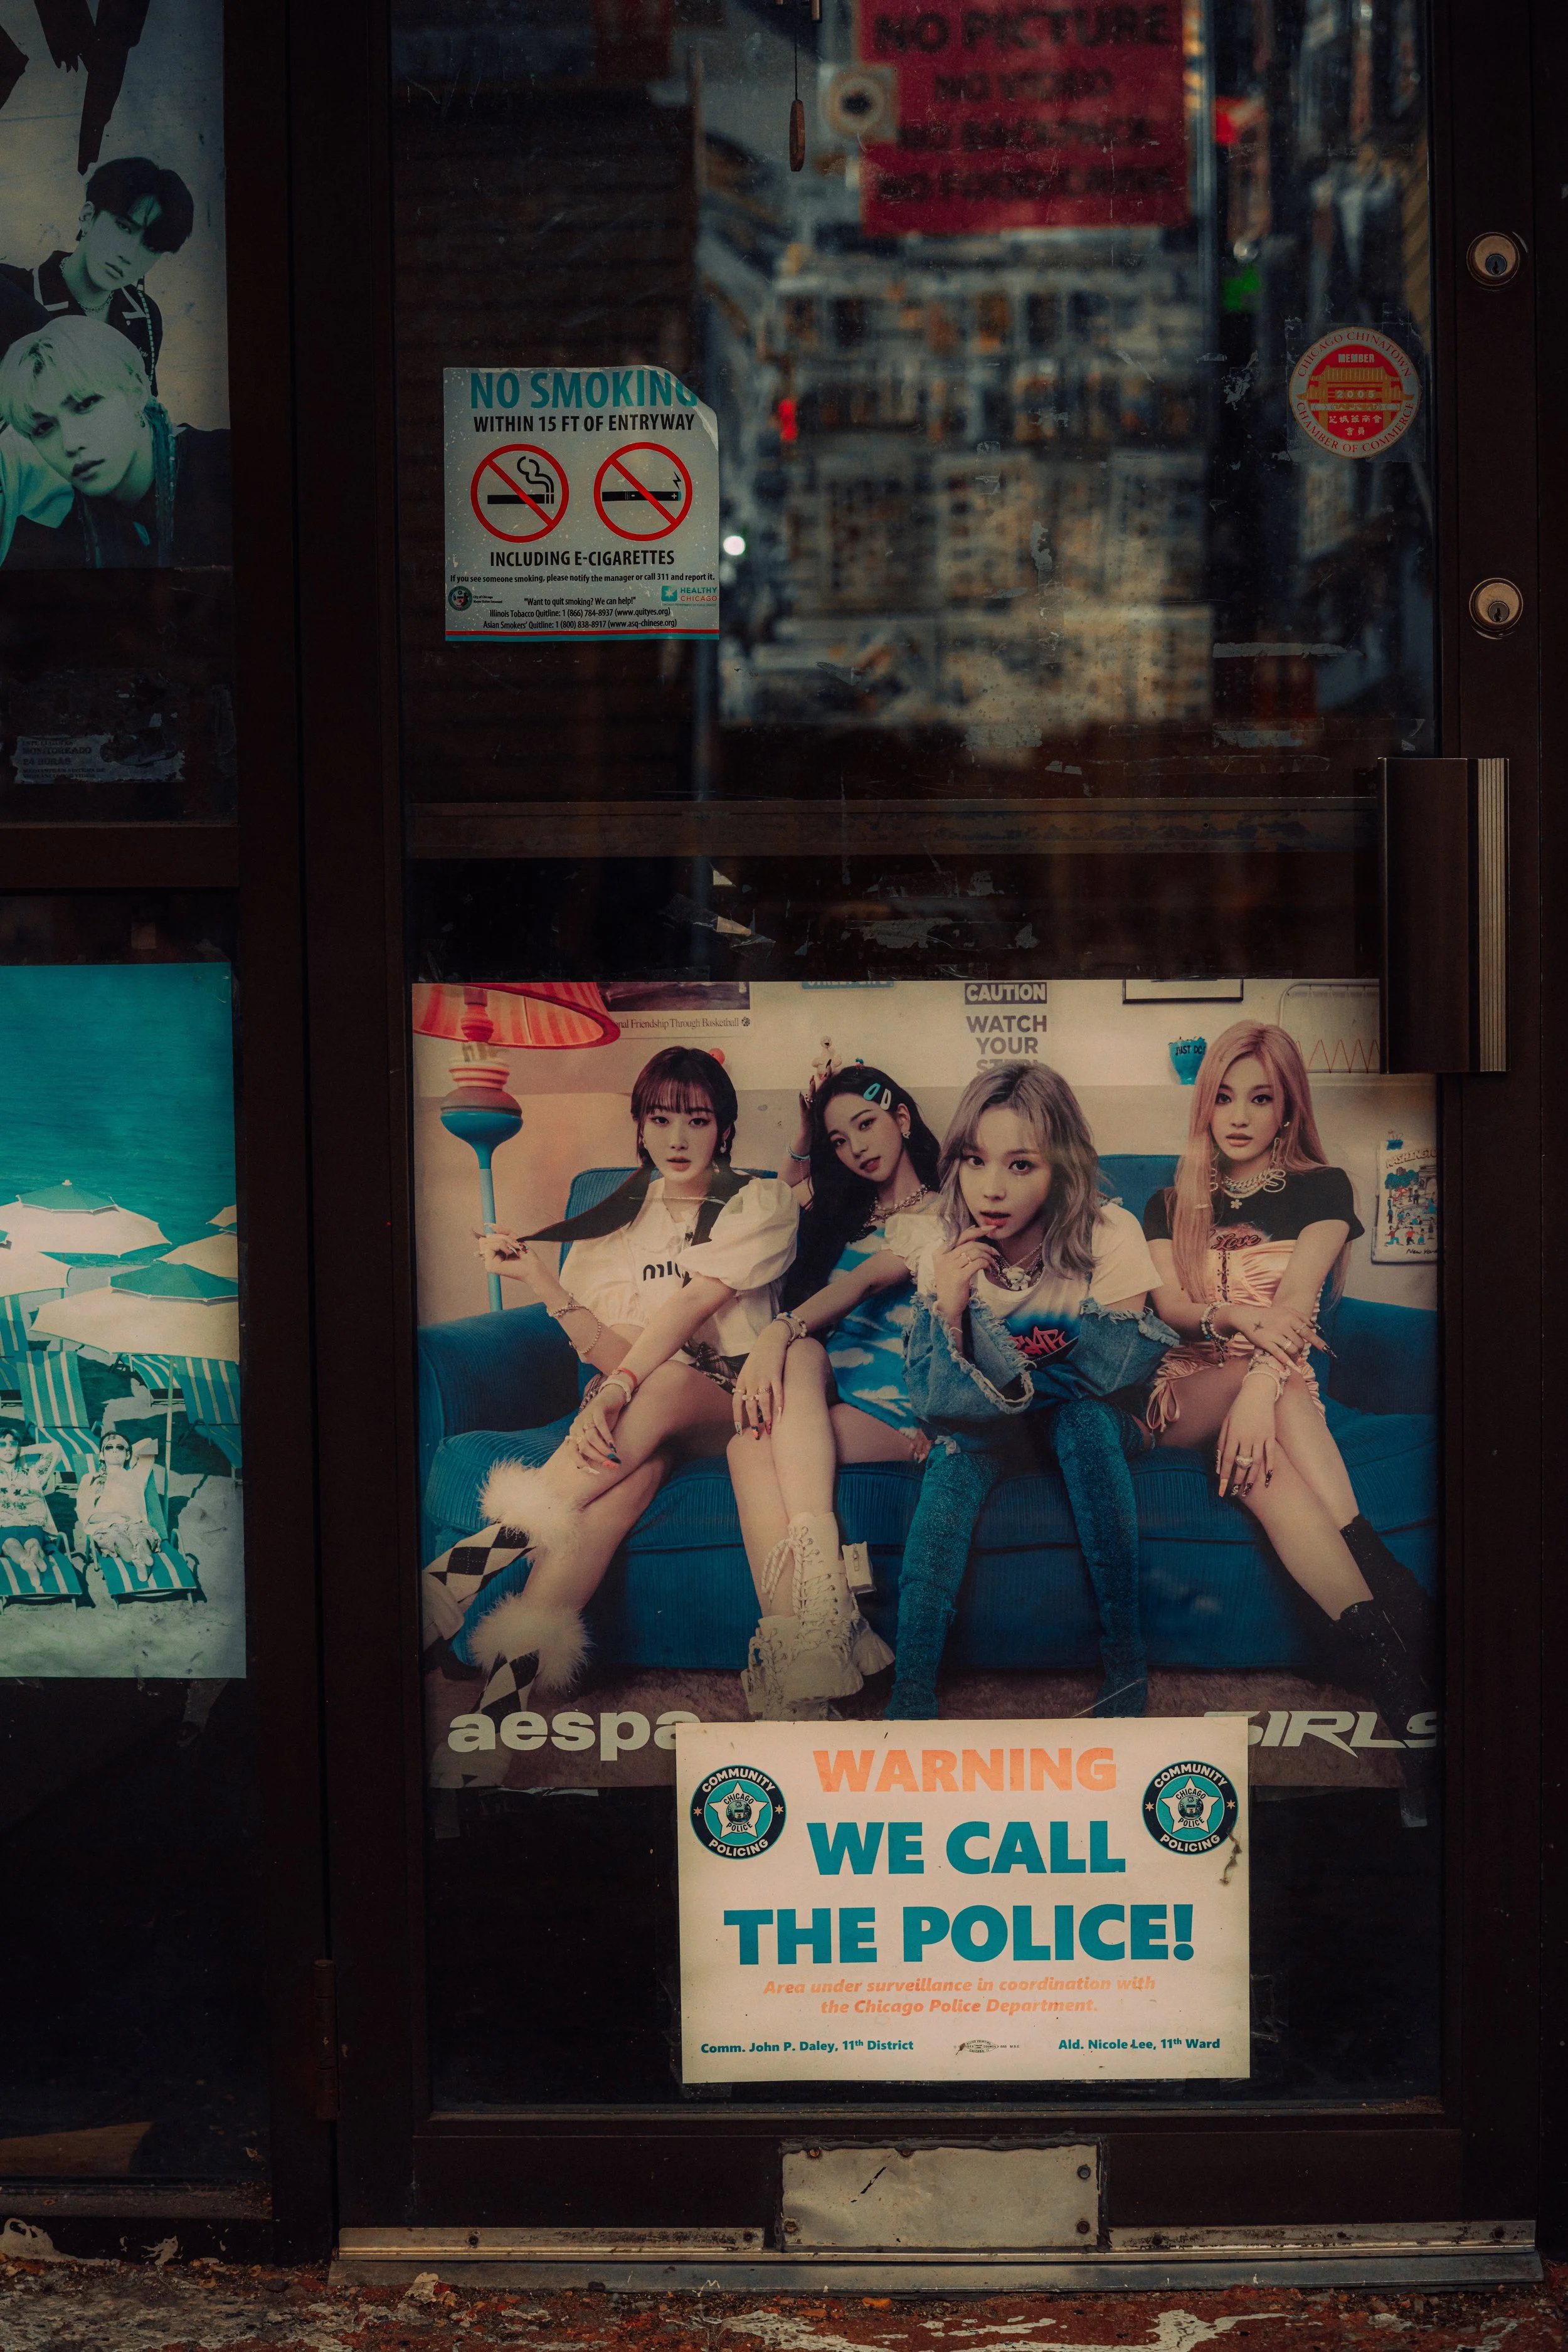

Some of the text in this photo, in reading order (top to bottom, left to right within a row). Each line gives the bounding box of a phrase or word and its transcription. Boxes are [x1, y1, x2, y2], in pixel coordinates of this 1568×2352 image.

[874, 11, 949, 53] NO
[1298, 332, 1412, 377] CHICAGO CHINATOWN
[1338, 354, 1375, 363] MEMBER
[471, 372, 519, 409] NO
[1337, 390, 1375, 399] 2005
[474, 413, 695, 433] WITHIN 15 FT OF ENTRYWAY
[1296, 402, 1414, 453] CHAMBER OF COMMERCE
[490, 550, 674, 566] INCLUDING E-CIGARETTES
[514, 575, 545, 583] smoking,
[547, 574, 568, 583] please
[569, 575, 589, 584] notify
[524, 598, 543, 606] "Want
[552, 598, 564, 607] quit
[565, 598, 594, 607] smoking?
[618, 596, 636, 606] help!"
[568, 609, 583, 618] (866)
[615, 608, 670, 617] (www.quityes.org)
[483, 620, 499, 629] Asian
[529, 620, 554, 629] Quitline:
[560, 620, 576, 629] (800)
[608, 619, 677, 628] (www.asq-chinese.org)
[38, 757, 72, 765] HORAS
[966, 983, 1046, 1002] CAUTION
[631, 1019, 669, 1030] Friendship
[670, 1019, 701, 1030] Through
[702, 1018, 739, 1027] Basketball
[966, 1015, 1047, 1033] WATCH
[975, 1037, 1039, 1055] YOUR
[1210, 1234, 1261, 1251] Love
[813, 1748, 1117, 1793] WARNING
[1154, 1764, 1228, 1788] COMMUNITY
[702, 1768, 776, 1793] COMMUNITY
[723, 1793, 754, 1805] CHICAGO
[1175, 1788, 1206, 1800] CHICAGO
[726, 1822, 753, 1832] POLICE
[1178, 1817, 1204, 1827] POLICE
[708, 1839, 768, 1857] POLICING
[807, 1820, 1126, 1875] WE CALL
[1160, 1834, 1220, 1852] POLICING
[724, 1904, 1194, 1965] THE POLICE!
[763, 1976, 1155, 1994] Area under surveillance in coordination with
[820, 1998, 1098, 2016] the Chicago Police Department.
[701, 2040, 914, 2053] Comm. John P. Daley, 11th District
[1058, 2038, 1221, 2050] Ald. Nicole Lee, 11th Ward
